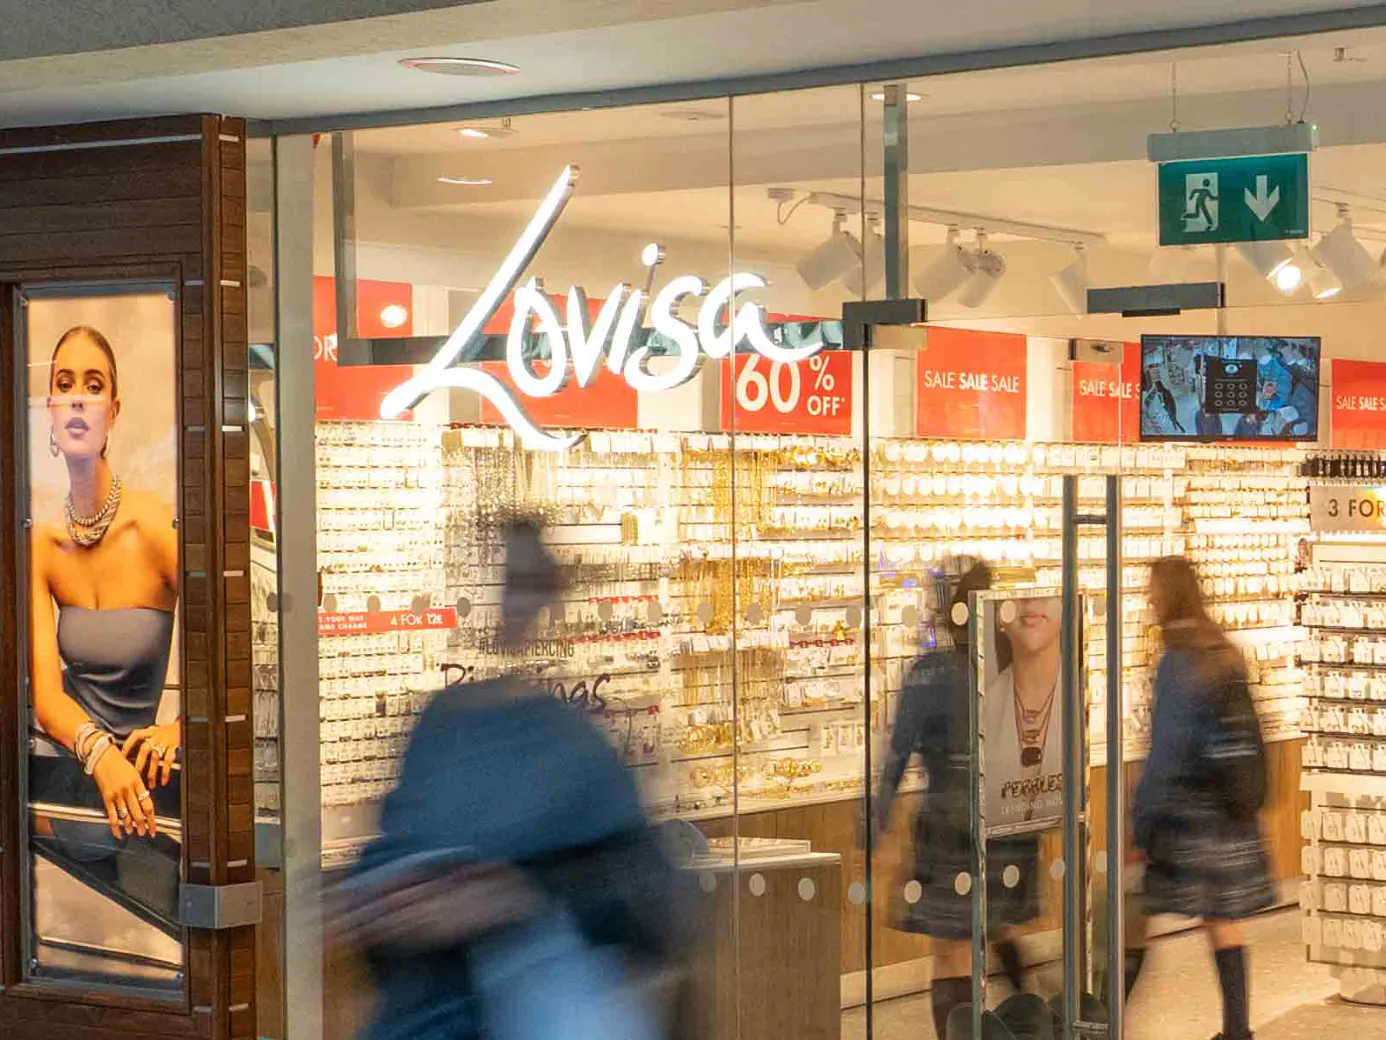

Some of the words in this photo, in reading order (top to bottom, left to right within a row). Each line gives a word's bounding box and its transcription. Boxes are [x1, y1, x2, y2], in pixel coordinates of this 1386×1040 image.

[380, 164, 824, 451] Lovisa
[924, 370, 955, 389] SALE
[959, 372, 988, 390] SALE
[991, 375, 1020, 393] SALE
[1079, 379, 1105, 397] SALE
[1109, 382, 1132, 398] SALE
[1336, 395, 1356, 410] SALE
[1359, 396, 1378, 411] SALE
[1328, 499, 1338, 517] 3
[1349, 499, 1386, 518] FOR
